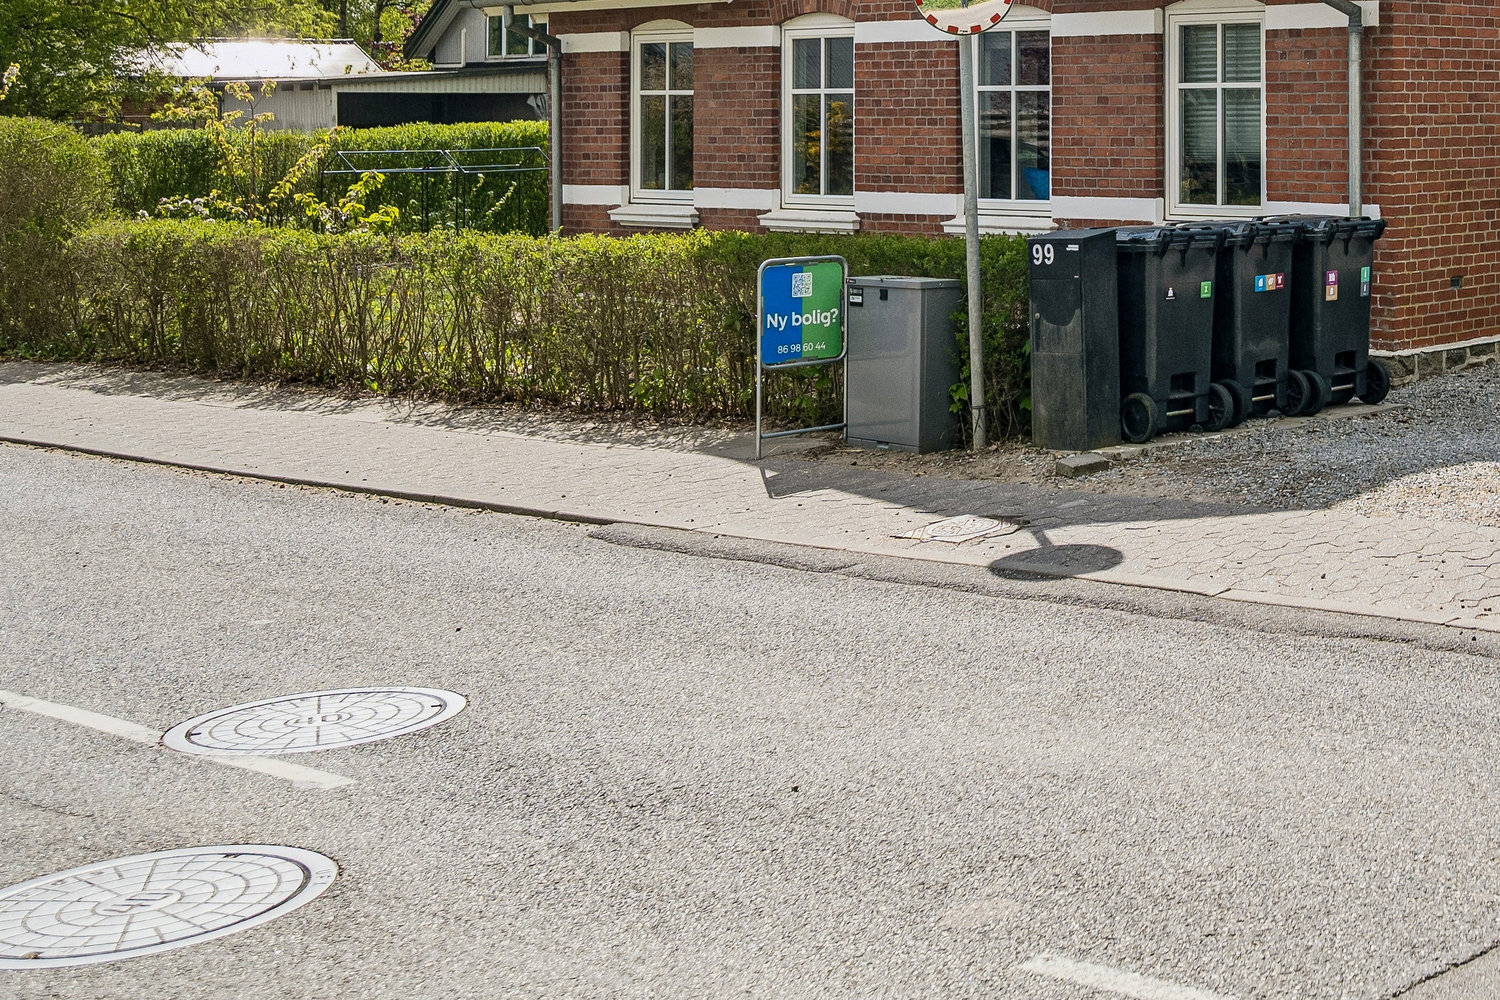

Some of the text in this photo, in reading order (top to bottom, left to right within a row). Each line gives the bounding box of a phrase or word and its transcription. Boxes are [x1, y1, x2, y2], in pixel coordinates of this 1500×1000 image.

[1032, 243, 1055, 266] 99
[766, 308, 839, 331] Ny bolig?
[777, 341, 826, 354] 86 98 60 44
